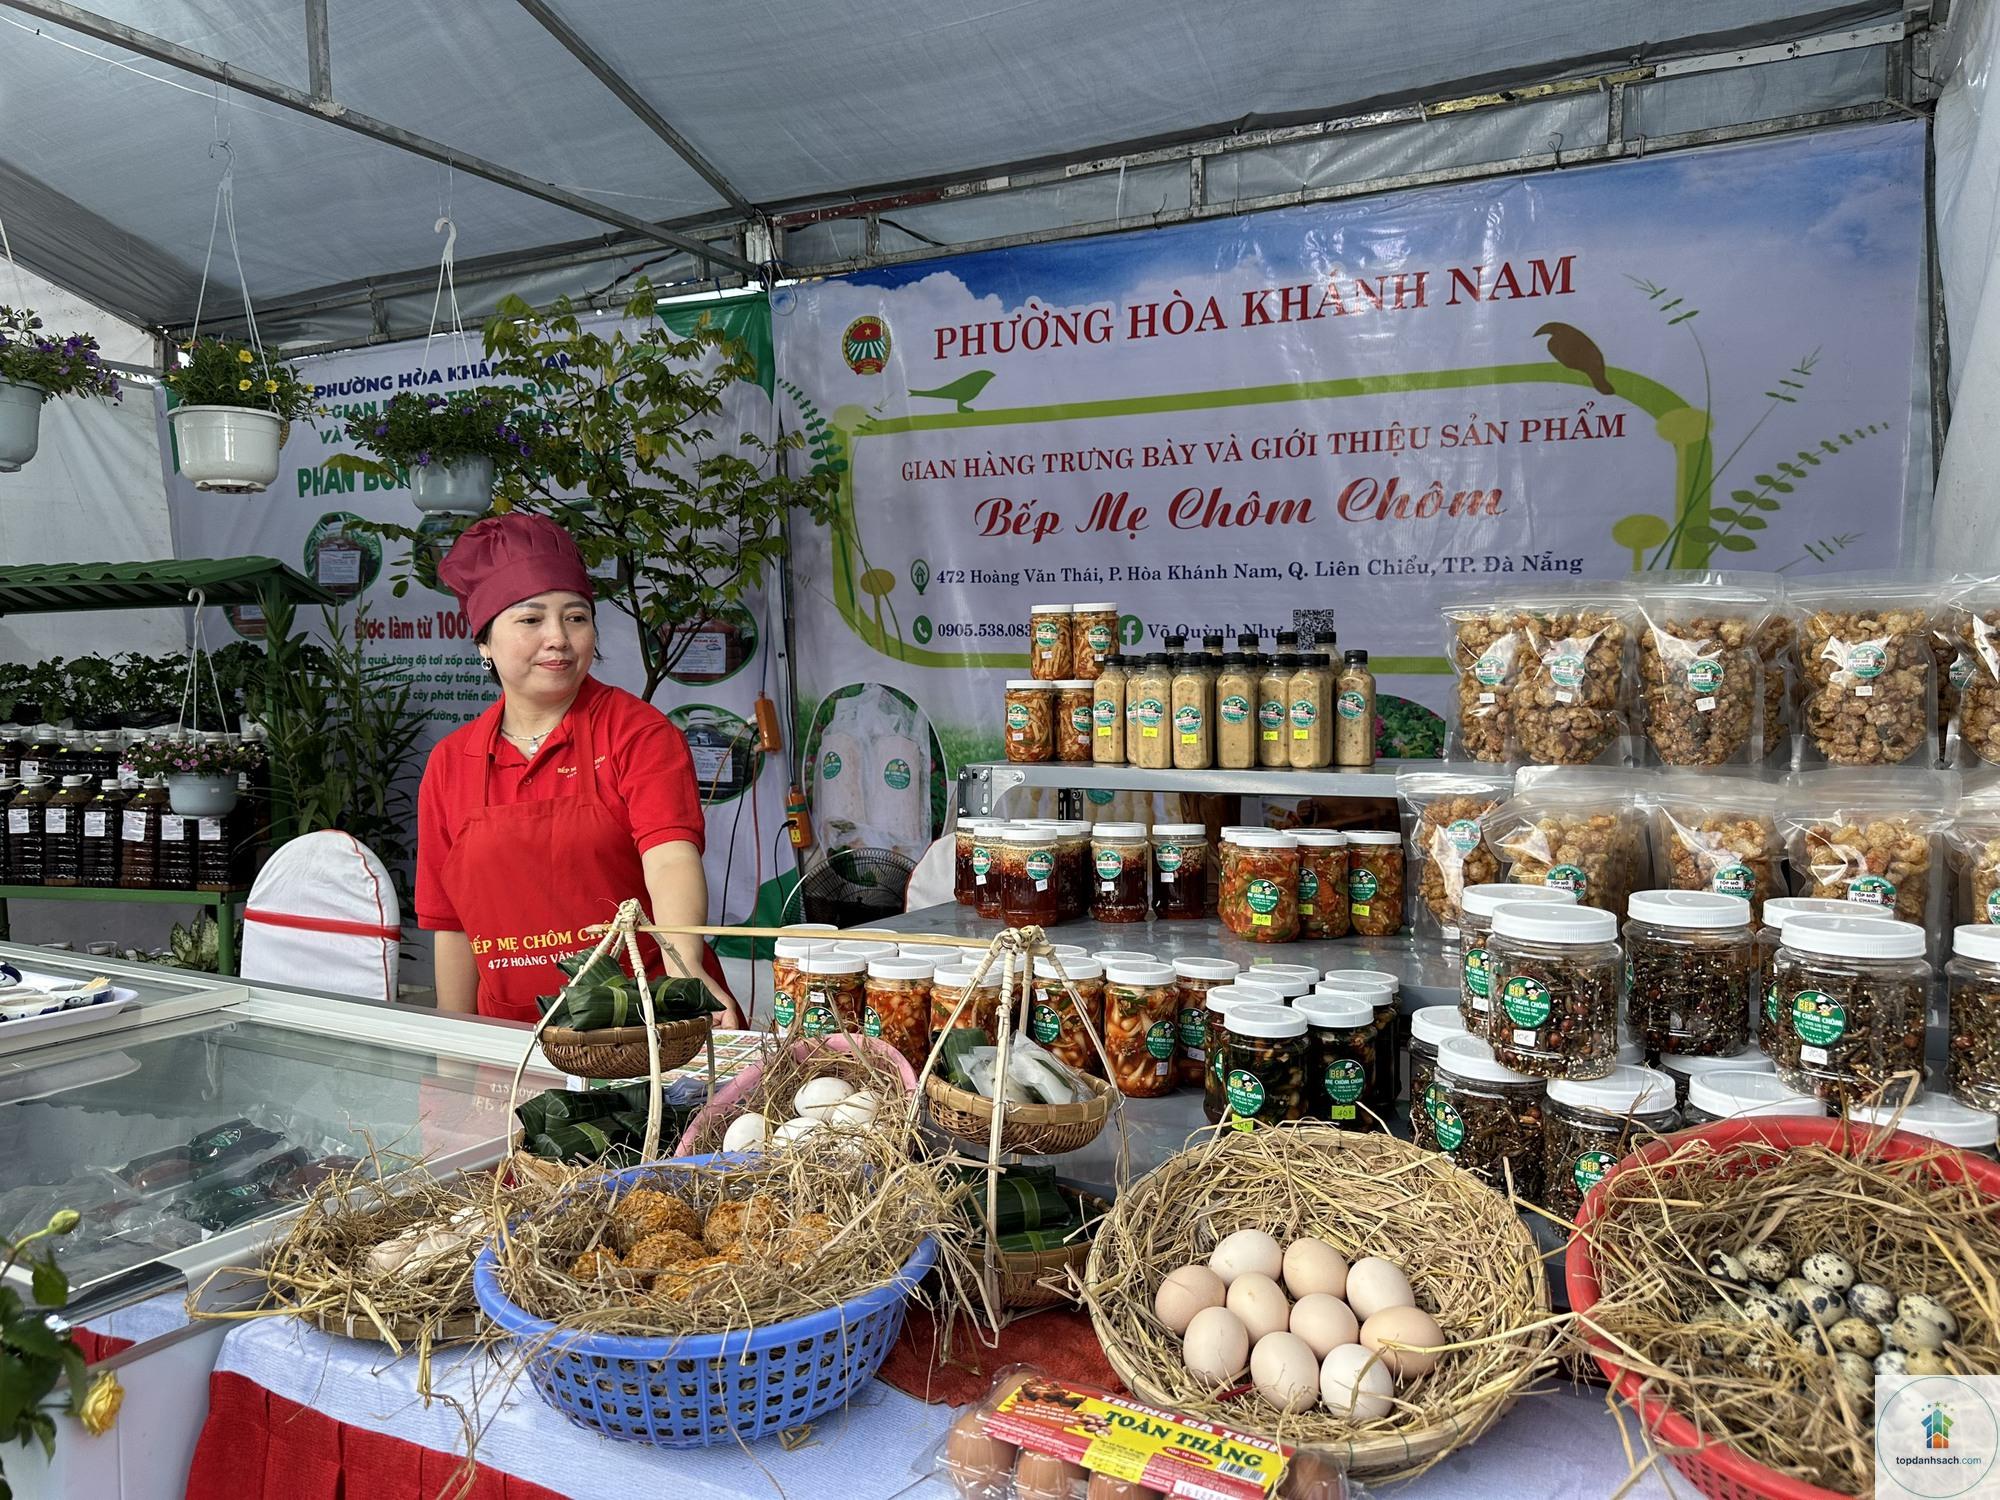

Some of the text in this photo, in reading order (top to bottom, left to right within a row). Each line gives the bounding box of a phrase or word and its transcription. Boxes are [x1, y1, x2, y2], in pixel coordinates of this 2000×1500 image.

[933, 256, 1578, 360] PHƯỜNG HÒA KHÁNH NAM
[314, 376, 393, 399] PHƯỜNG
[398, 368, 443, 388] HÒA
[319, 425, 343, 444] VÀ
[902, 401, 1627, 482] GIAN HÀNG TRƯNG BÀY VÀ GIỚI THIỆU SẢN PHẨM
[974, 476, 1508, 545] Bếp Mẹ Chôm Chôm
[936, 550, 1584, 587] 472 Hoàng Văn Thái, P. Hòa Khánh Nam, Q. Liên Chiểu, TP. Đà Nẵng
[389, 616, 415, 640] làm
[417, 615, 433, 640] từ
[937, 622, 1032, 640] 0905.538.083
[496, 936, 519, 953] MẸ
[522, 929, 573, 950] CHÔM
[488, 958, 509, 970] 472
[510, 955, 547, 968] HOÀNG
[1104, 1409, 1171, 1439] TOÀN
[1175, 1436, 1263, 1467] THẮNG
